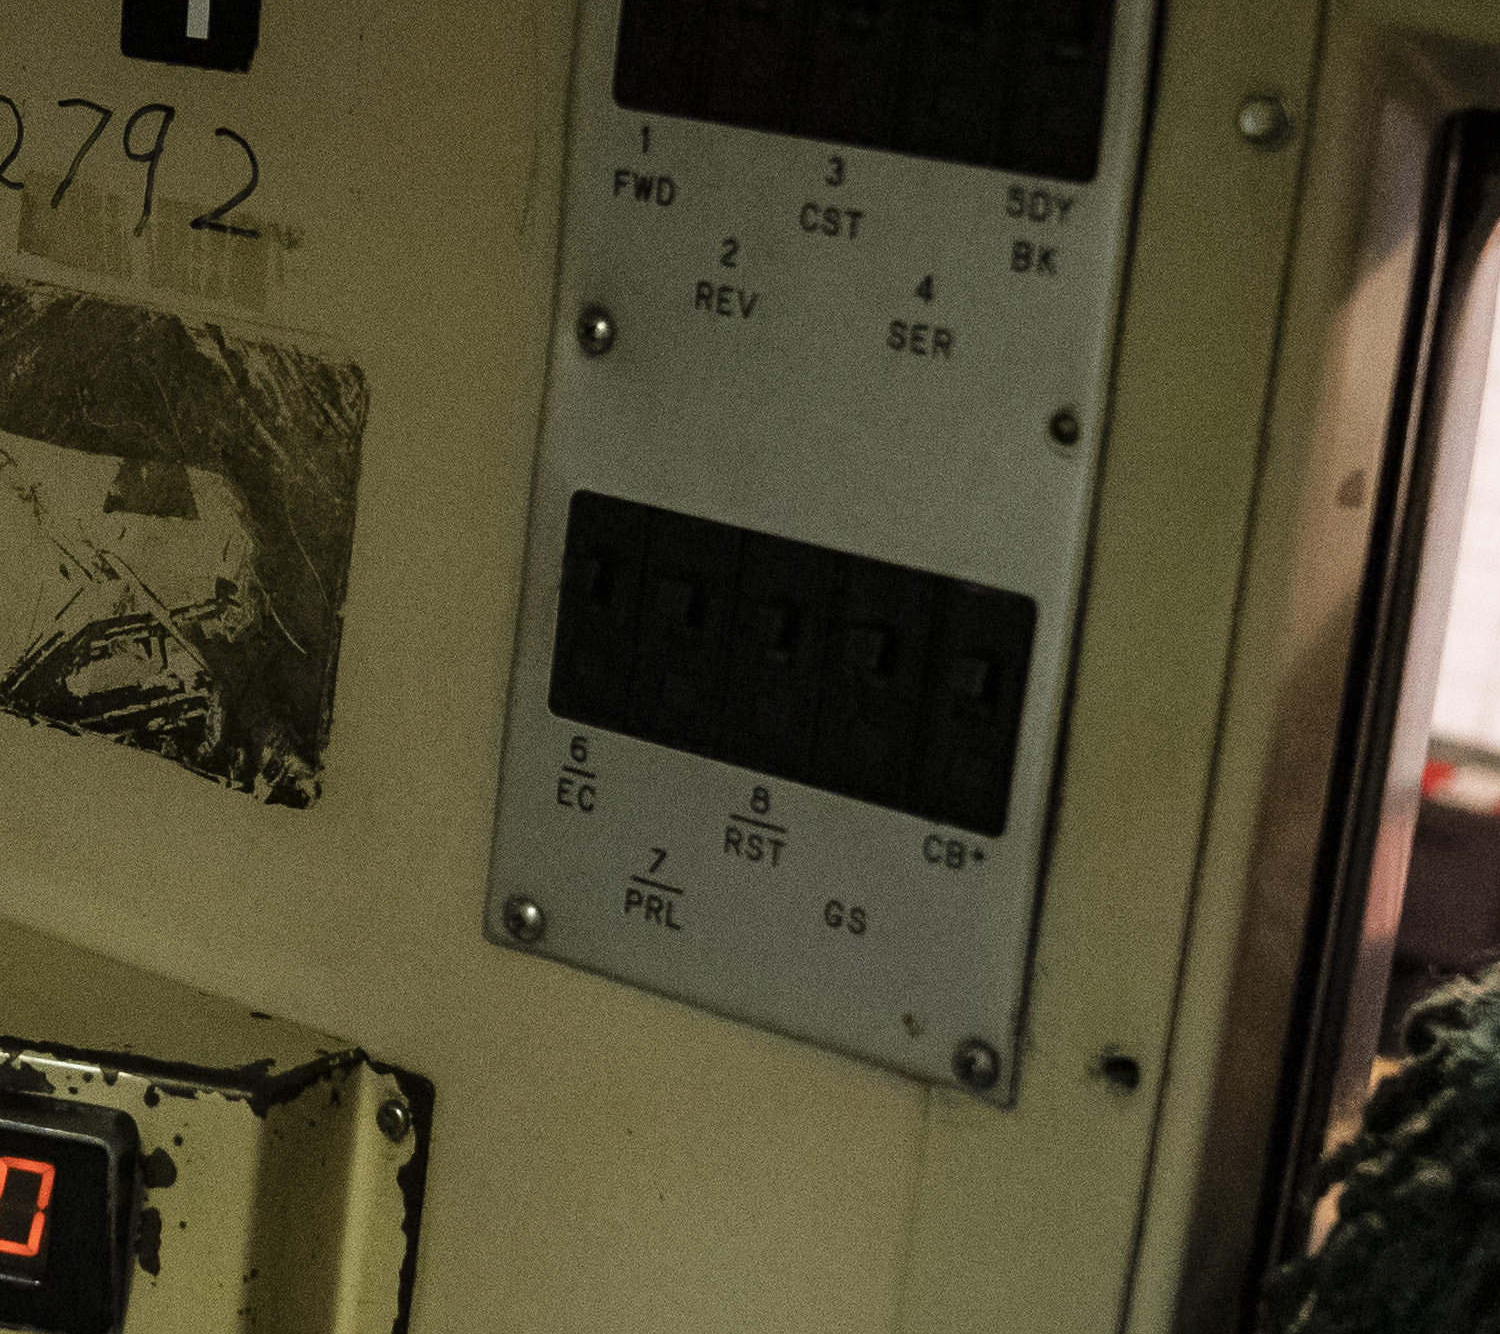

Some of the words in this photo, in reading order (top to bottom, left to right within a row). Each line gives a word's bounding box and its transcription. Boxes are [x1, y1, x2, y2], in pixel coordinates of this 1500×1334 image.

[638, 123, 652, 156] 1
[611, 167, 679, 209] FWD
[824, 153, 849, 189] 3
[798, 200, 868, 241] CST
[718, 235, 742, 270] 2
[1008, 238, 1060, 279] BK
[692, 278, 761, 322] REV
[913, 272, 937, 306] 4
[884, 318, 958, 361] SER
[567, 733, 591, 766] 6
[554, 775, 600, 815] EC
[748, 784, 774, 816] 8
[647, 845, 670, 877] 7
[721, 823, 790, 870] RST
[621, 886, 686, 934] PRL
[821, 896, 871, 938] GS
